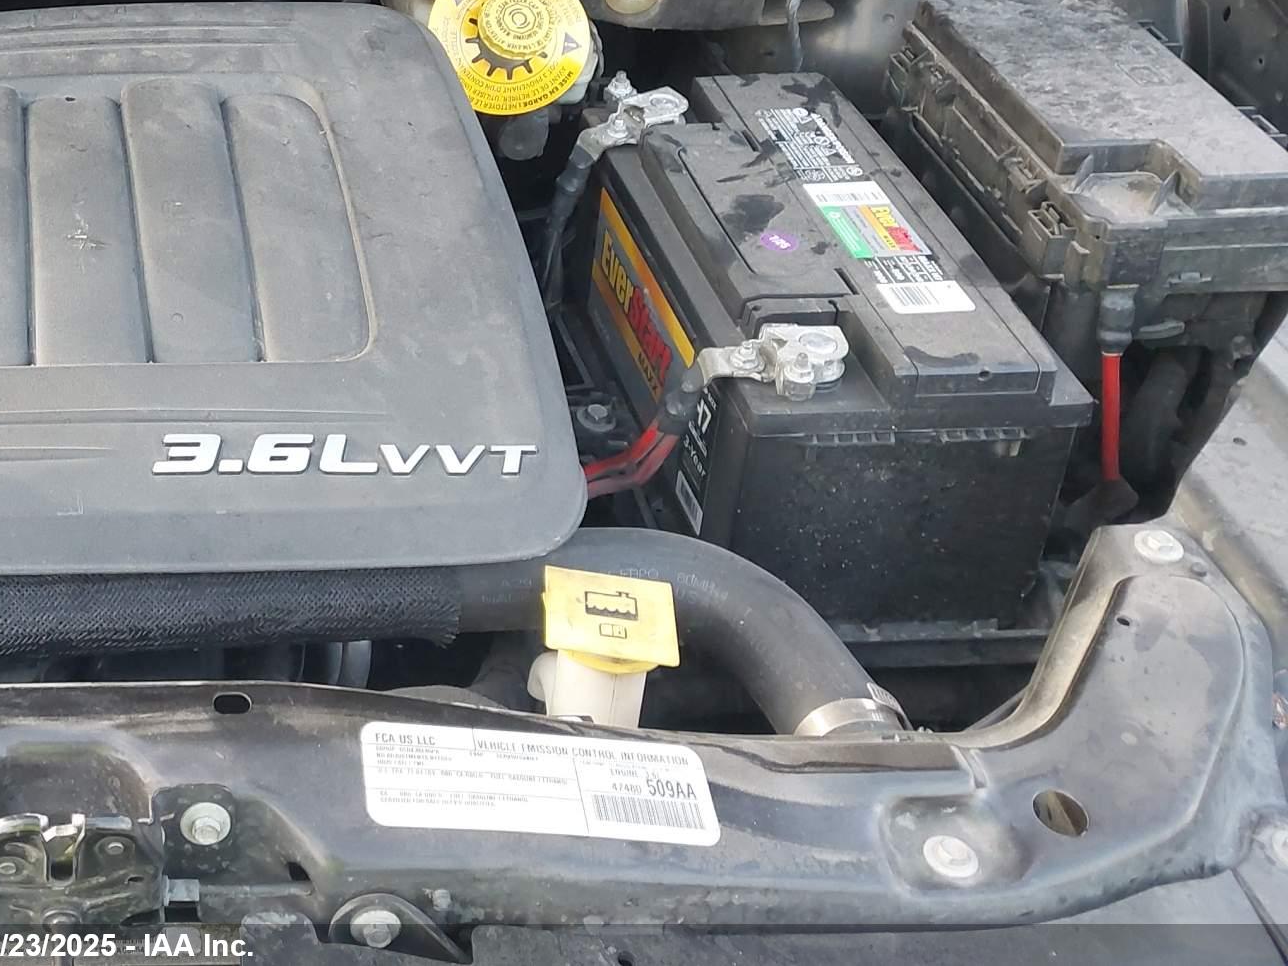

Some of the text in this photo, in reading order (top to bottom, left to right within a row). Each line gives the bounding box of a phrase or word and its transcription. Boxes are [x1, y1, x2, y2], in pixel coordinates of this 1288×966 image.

[560, 70, 574, 86] MISE
[524, 93, 549, 107] GARDE
[682, 434, 707, 478] 3-Year
[375, 732, 436, 746] FCA US LLC
[476, 740, 516, 752] VEHICLE
[520, 743, 569, 756] EMISSION
[572, 747, 617, 760] CONTROL
[621, 751, 689, 767] INFORMATION
[645, 778, 697, 800] 509AA
